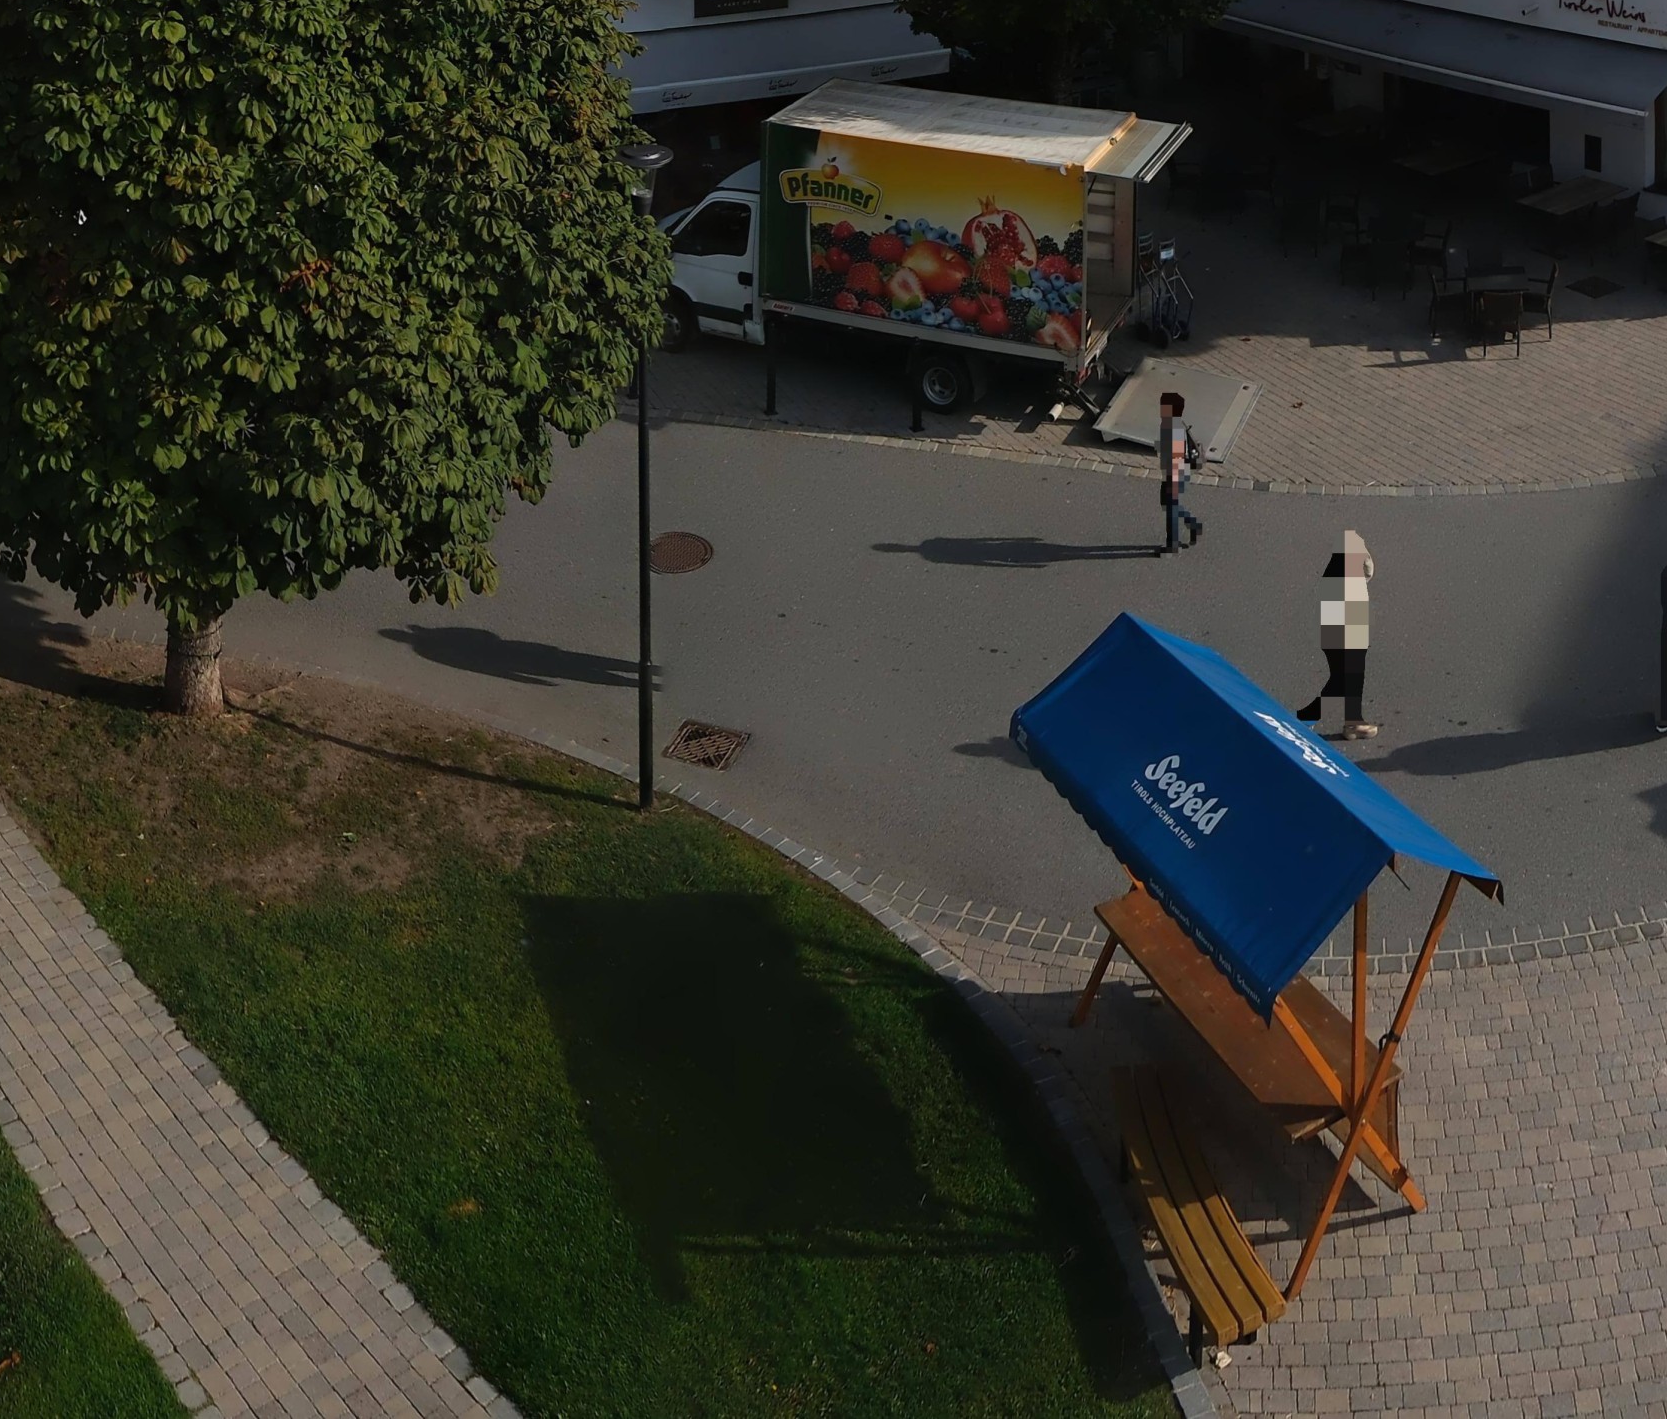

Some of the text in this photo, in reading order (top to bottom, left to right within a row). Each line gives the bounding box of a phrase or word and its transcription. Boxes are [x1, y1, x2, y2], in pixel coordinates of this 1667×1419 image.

[1598, 19, 1632, 31] RESTAURANT
[1130, 779, 1196, 850] TIROLS HOCHPLATEAU
[1144, 754, 1229, 835] Seefeld
